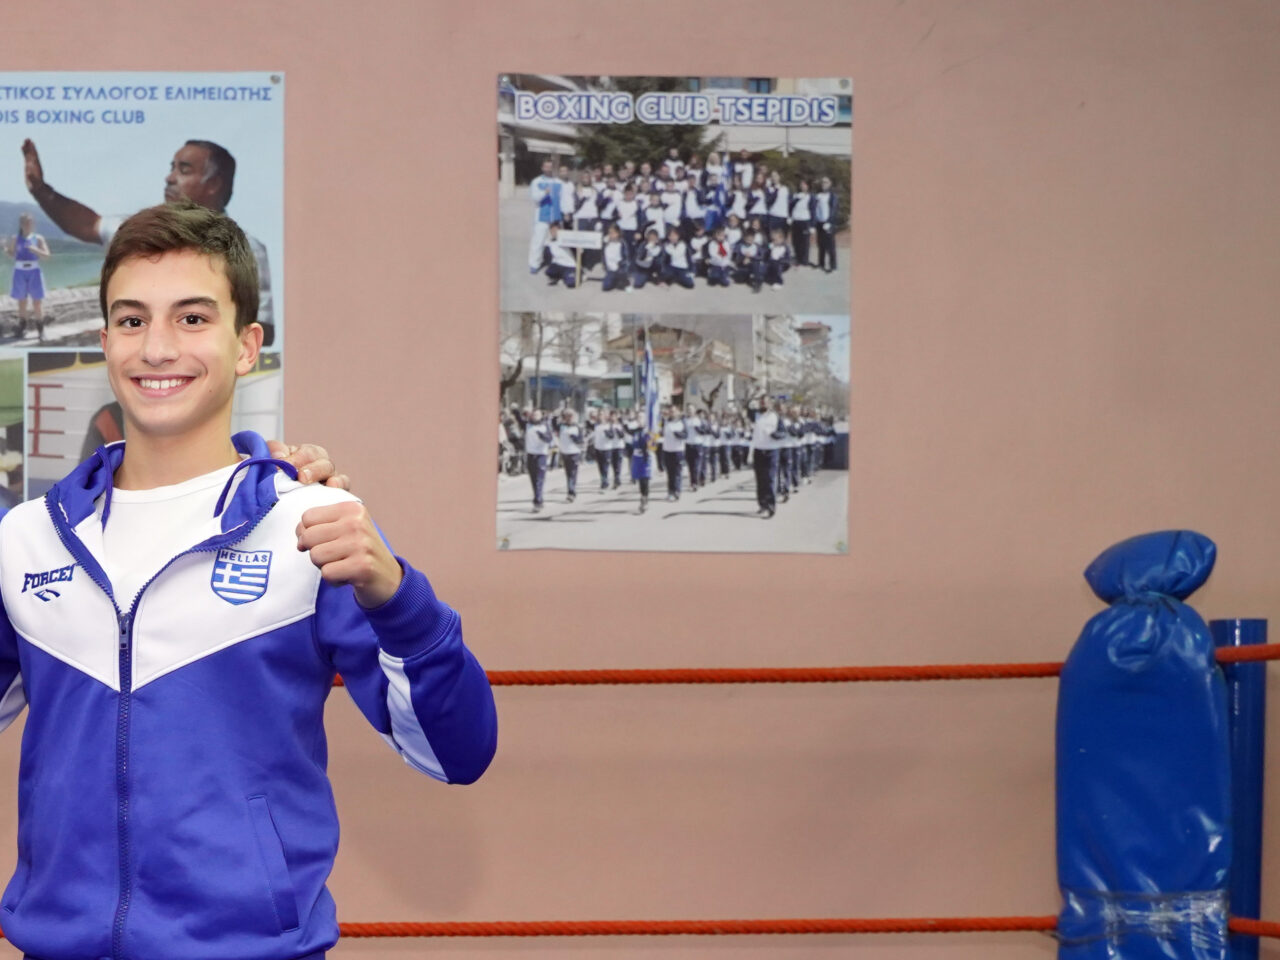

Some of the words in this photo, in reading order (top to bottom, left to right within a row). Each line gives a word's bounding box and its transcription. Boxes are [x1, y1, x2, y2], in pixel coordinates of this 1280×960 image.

[62, 86, 158, 101] ΣΥΛΛΟΓΟΣ
[165, 86, 273, 101] ΕΛΙΜΕΙΩΤΗΣ
[25, 109, 95, 124] BOXING
[101, 109, 146, 124] CLUB
[517, 93, 632, 123] BOXING
[637, 93, 711, 124] CLUB
[718, 95, 837, 125] TSEPIDIS
[220, 550, 268, 563] HELLAS
